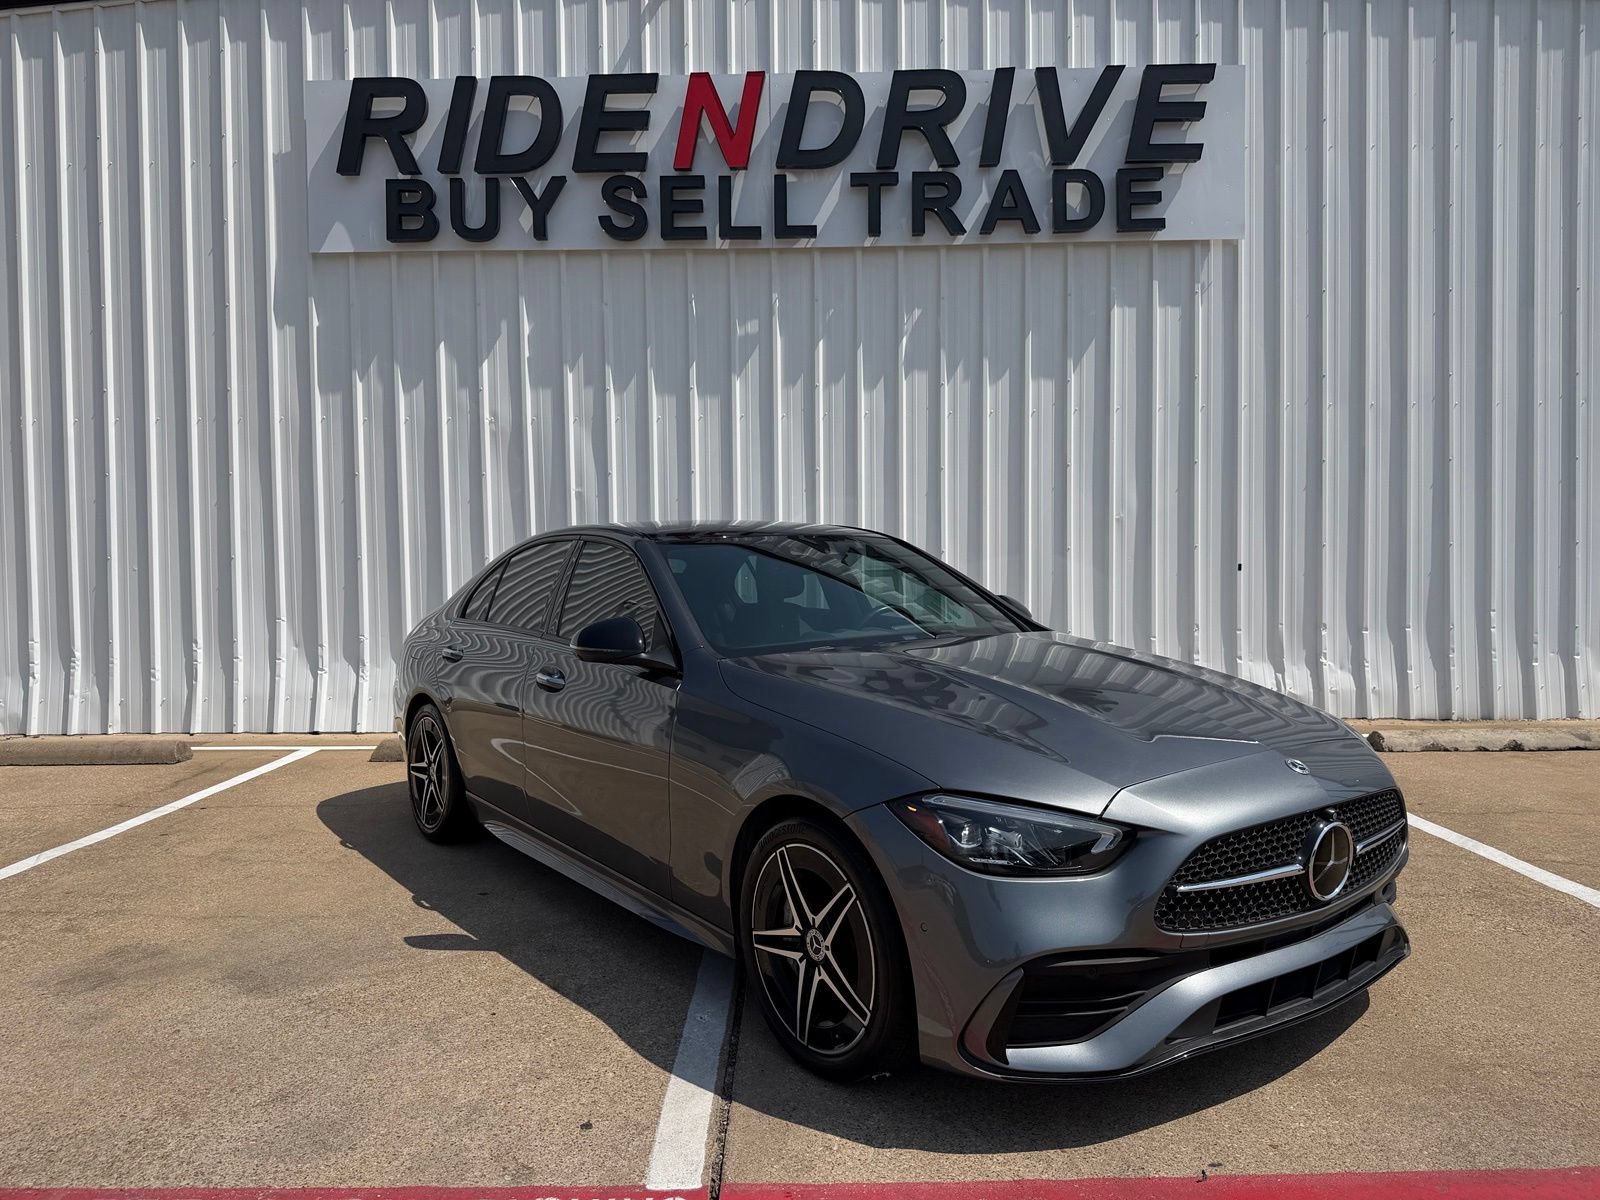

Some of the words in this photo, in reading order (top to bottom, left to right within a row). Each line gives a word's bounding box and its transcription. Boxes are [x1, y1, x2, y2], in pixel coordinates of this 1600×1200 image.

[385, 176, 567, 242] BUY
[598, 174, 817, 242] SELL
[850, 167, 1166, 237] TRADE
